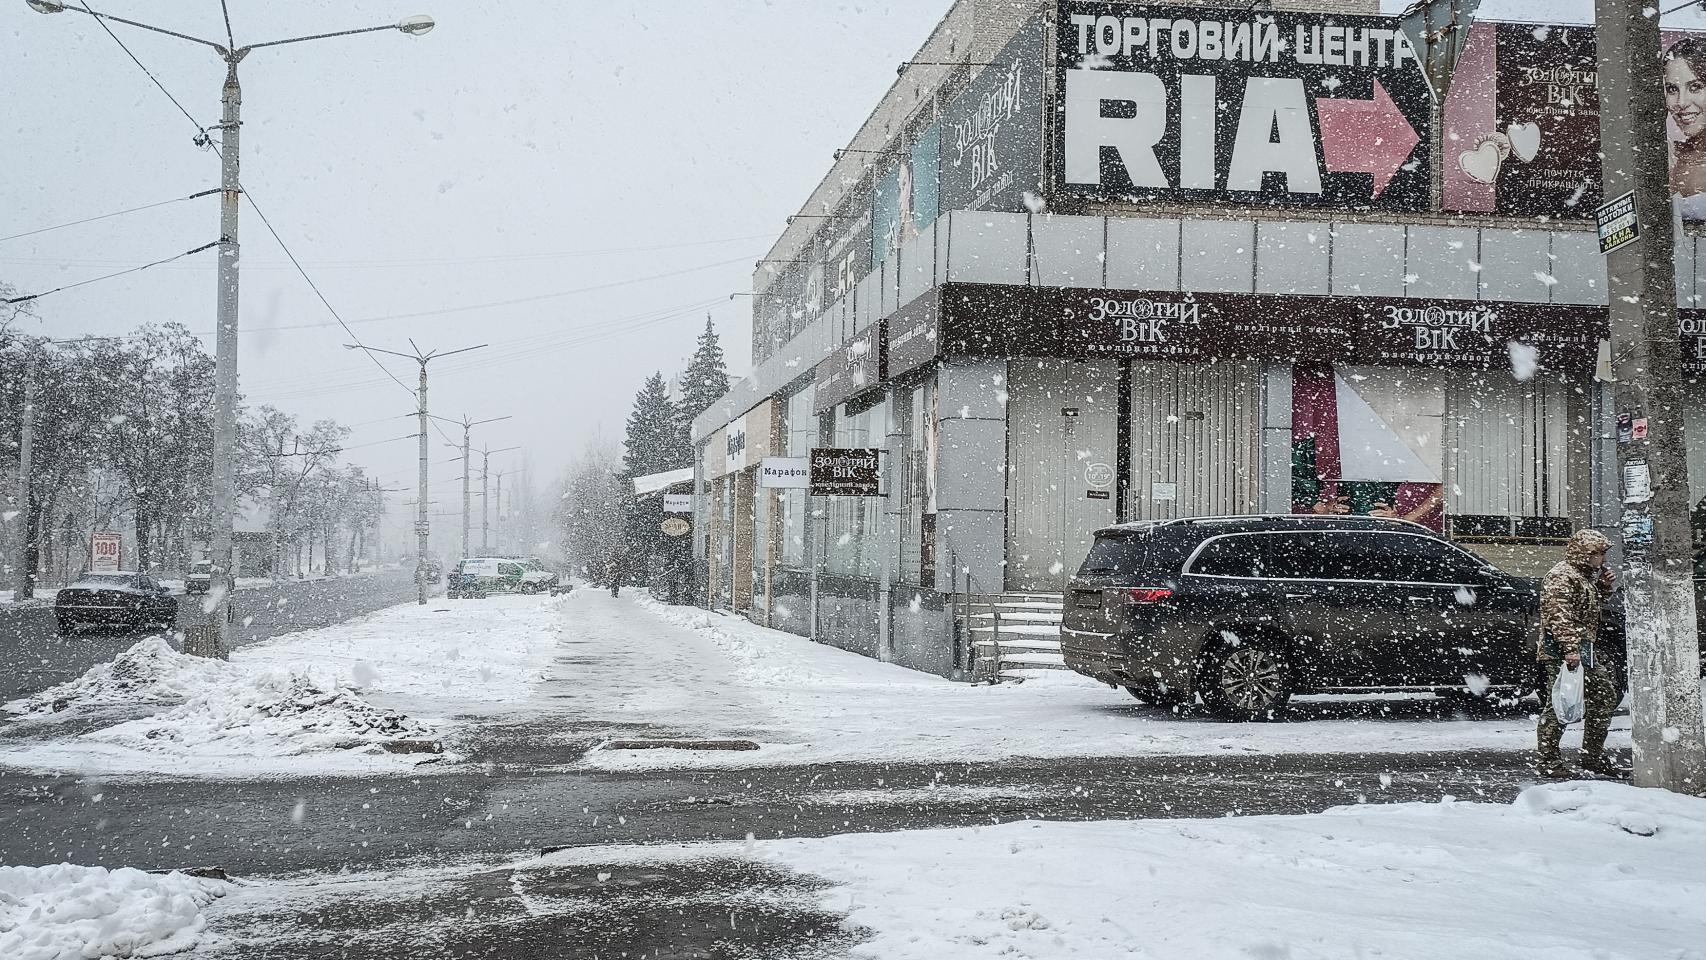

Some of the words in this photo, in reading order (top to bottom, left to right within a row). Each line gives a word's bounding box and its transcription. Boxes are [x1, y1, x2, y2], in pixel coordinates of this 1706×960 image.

[1071, 14, 1279, 63] ТОРГОВИЙ
[1065, 69, 1322, 196] RIA
[1598, 203, 1633, 225] ПОТОЛКИ
[1606, 227, 1631, 243] ОКНА
[1088, 296, 1199, 324] ЗОЛОТИЙ
[1382, 305, 1491, 332] ЗОЛОТИЙ
[764, 467, 807, 478] Марафон
[95, 541, 117, 555] 100
